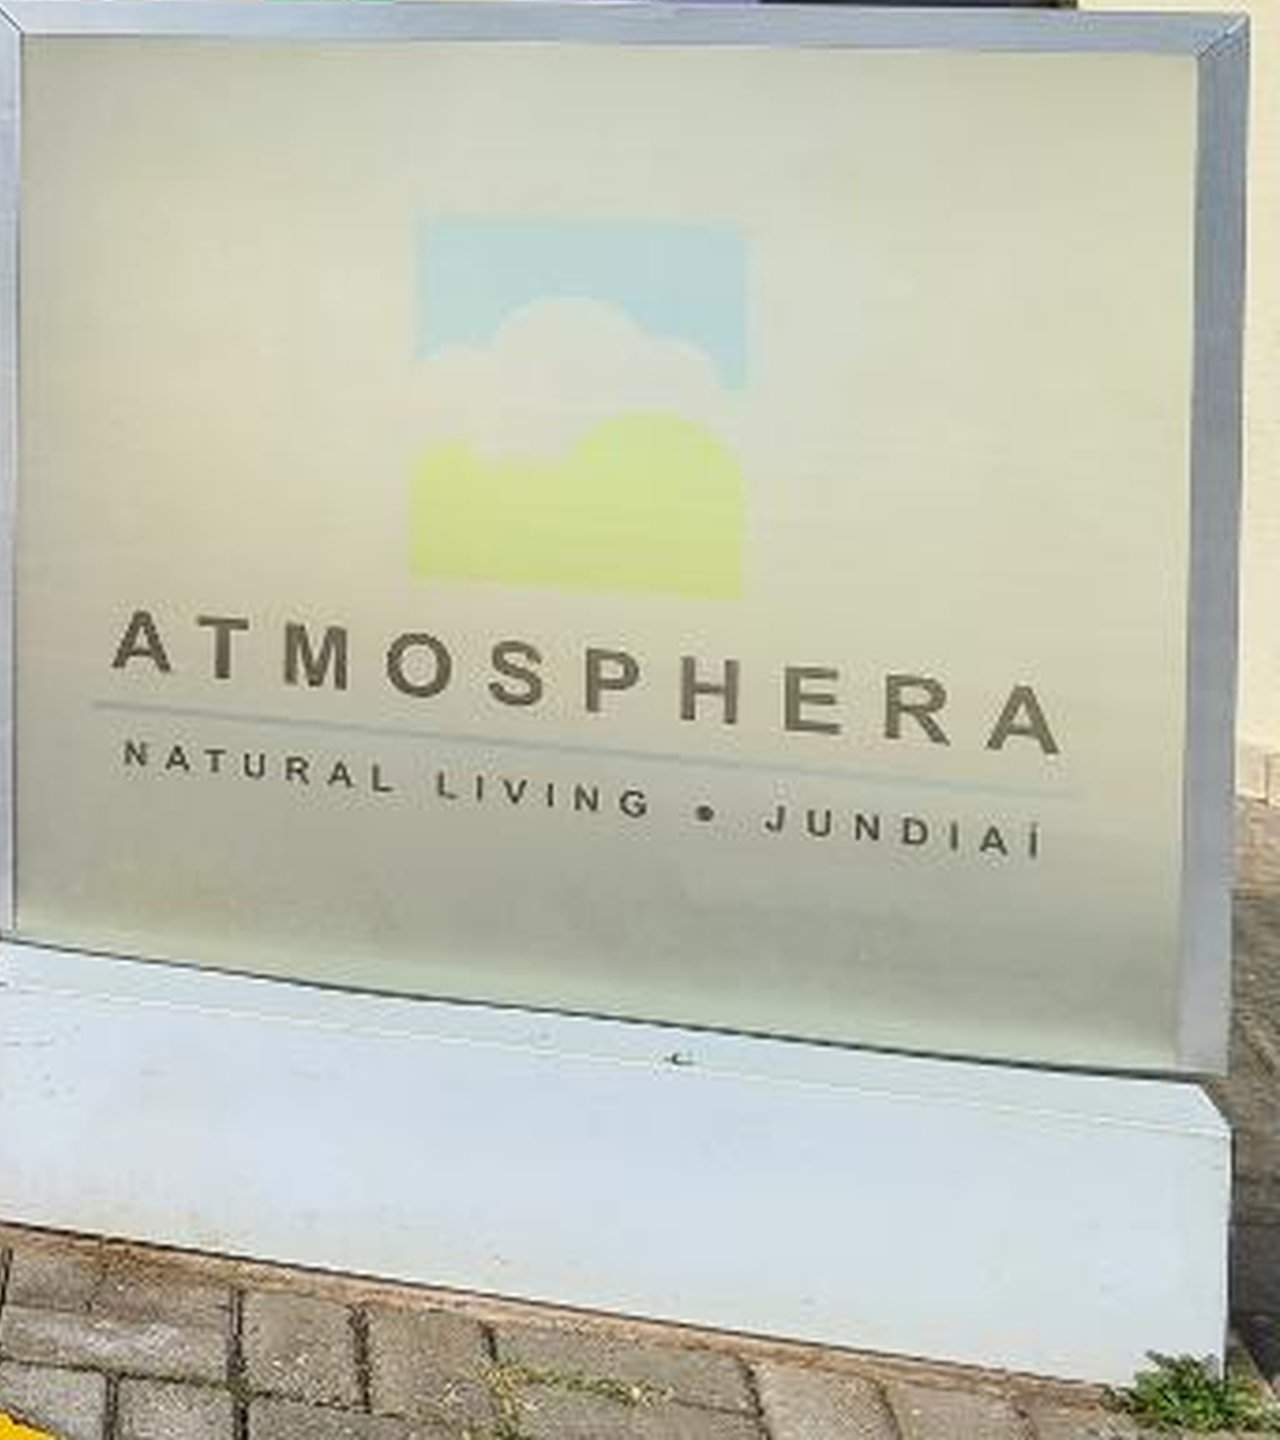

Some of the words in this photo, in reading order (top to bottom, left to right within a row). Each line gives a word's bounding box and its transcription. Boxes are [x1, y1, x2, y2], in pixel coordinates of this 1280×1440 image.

[112, 610, 1061, 754] ATMOSPHERA
[123, 739, 394, 794] NATURAL
[437, 770, 647, 818] LIVING
[765, 804, 1040, 859] JUNDIAÍ
